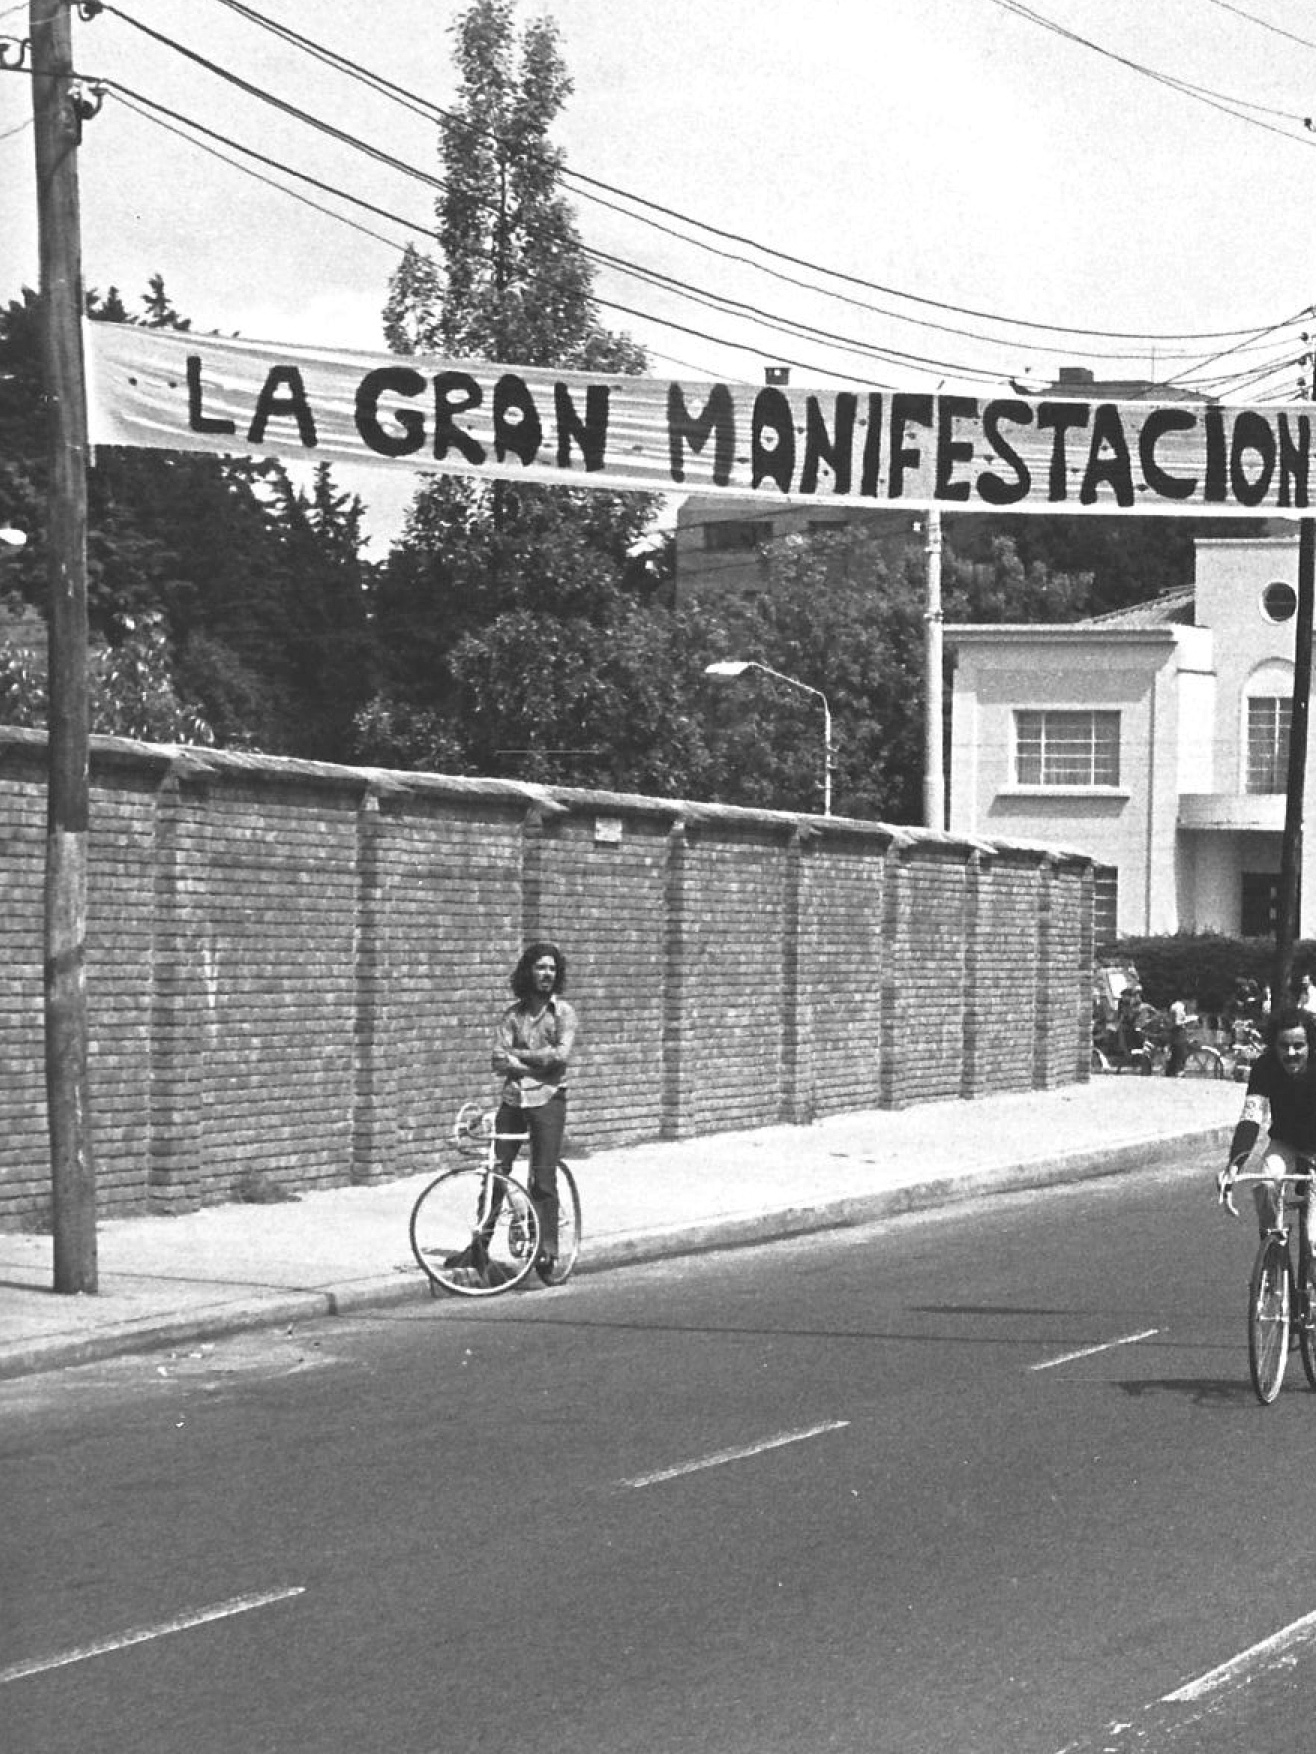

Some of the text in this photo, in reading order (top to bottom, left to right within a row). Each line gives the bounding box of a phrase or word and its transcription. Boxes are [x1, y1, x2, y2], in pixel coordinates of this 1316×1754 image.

[186, 355, 318, 448] LA
[355, 365, 610, 472] GRAN
[667, 381, 1310, 509] MANIFESTACION
